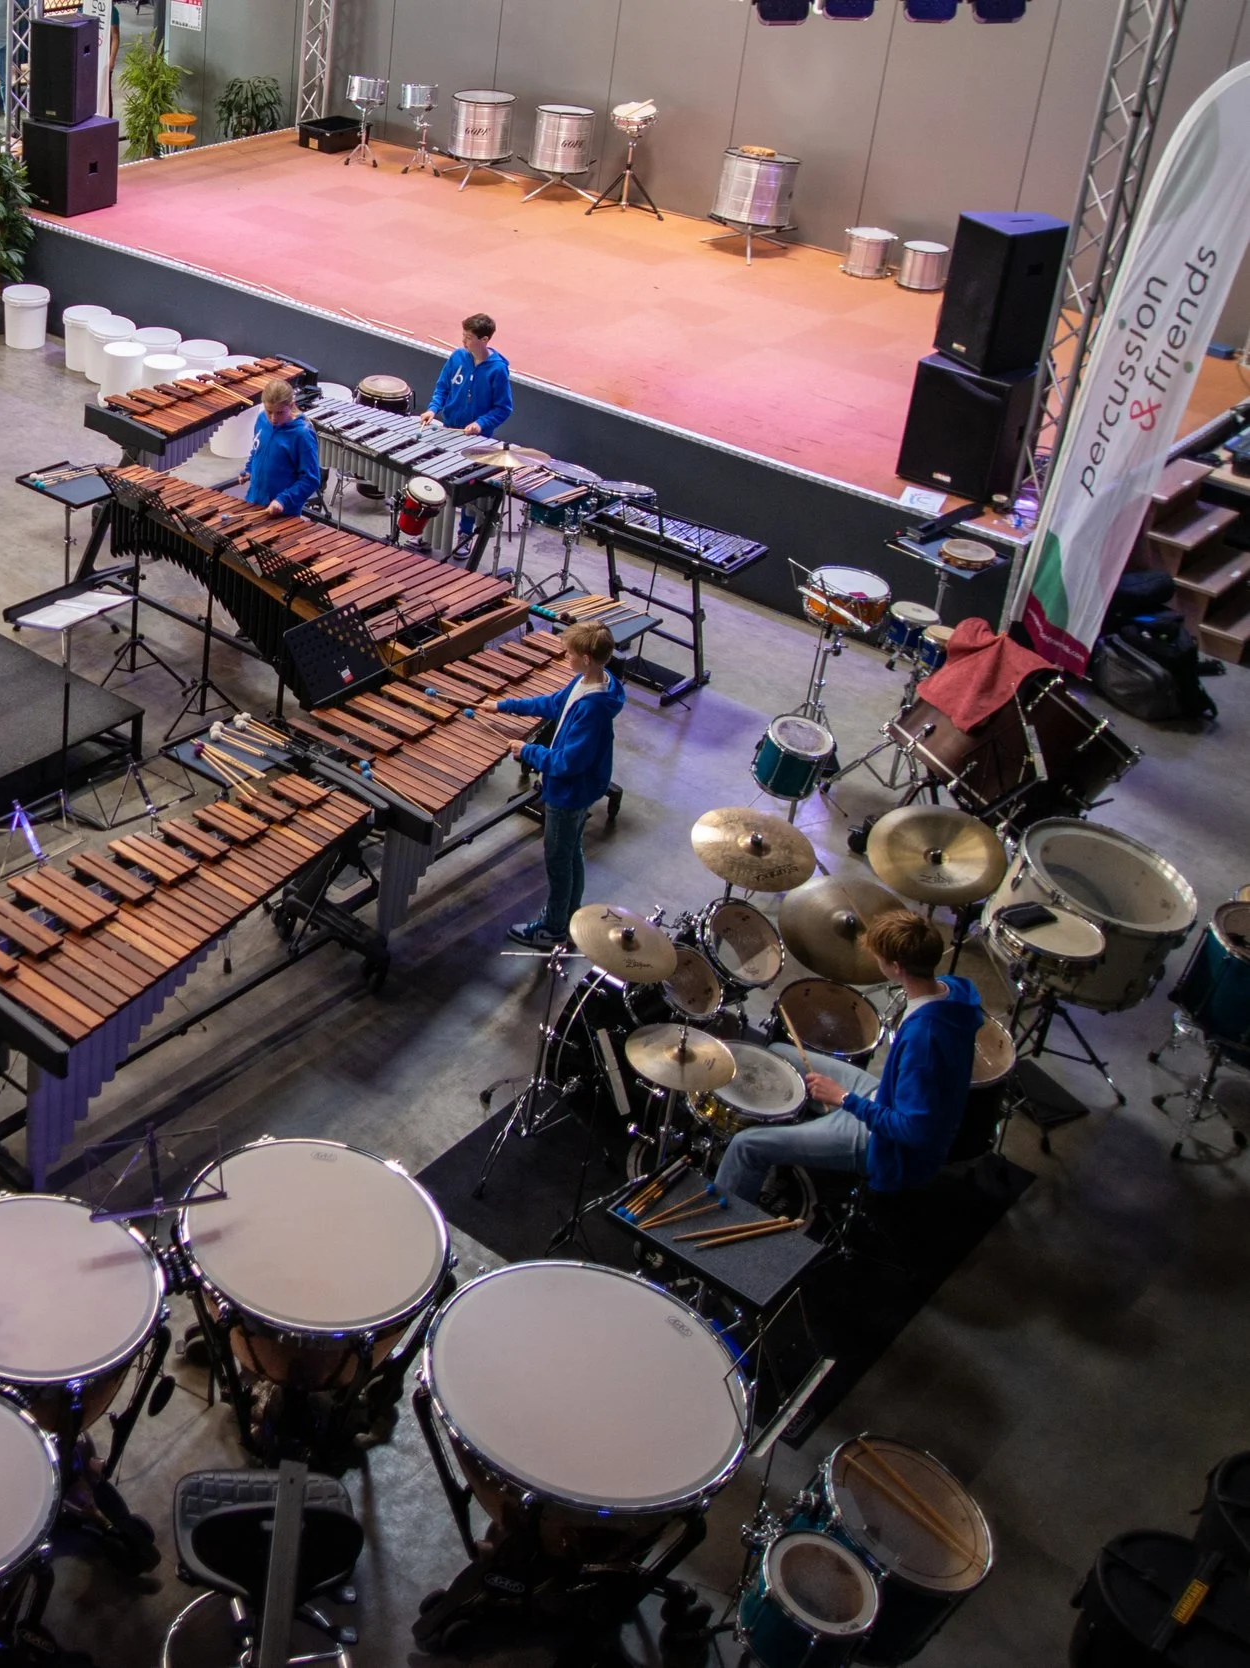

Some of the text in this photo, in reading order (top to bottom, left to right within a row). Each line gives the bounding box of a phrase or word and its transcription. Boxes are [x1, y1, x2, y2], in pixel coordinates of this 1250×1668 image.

[464, 127, 491, 136] GOPE
[1080, 275, 1168, 498] percussion
[1129, 246, 1217, 432] & friends
